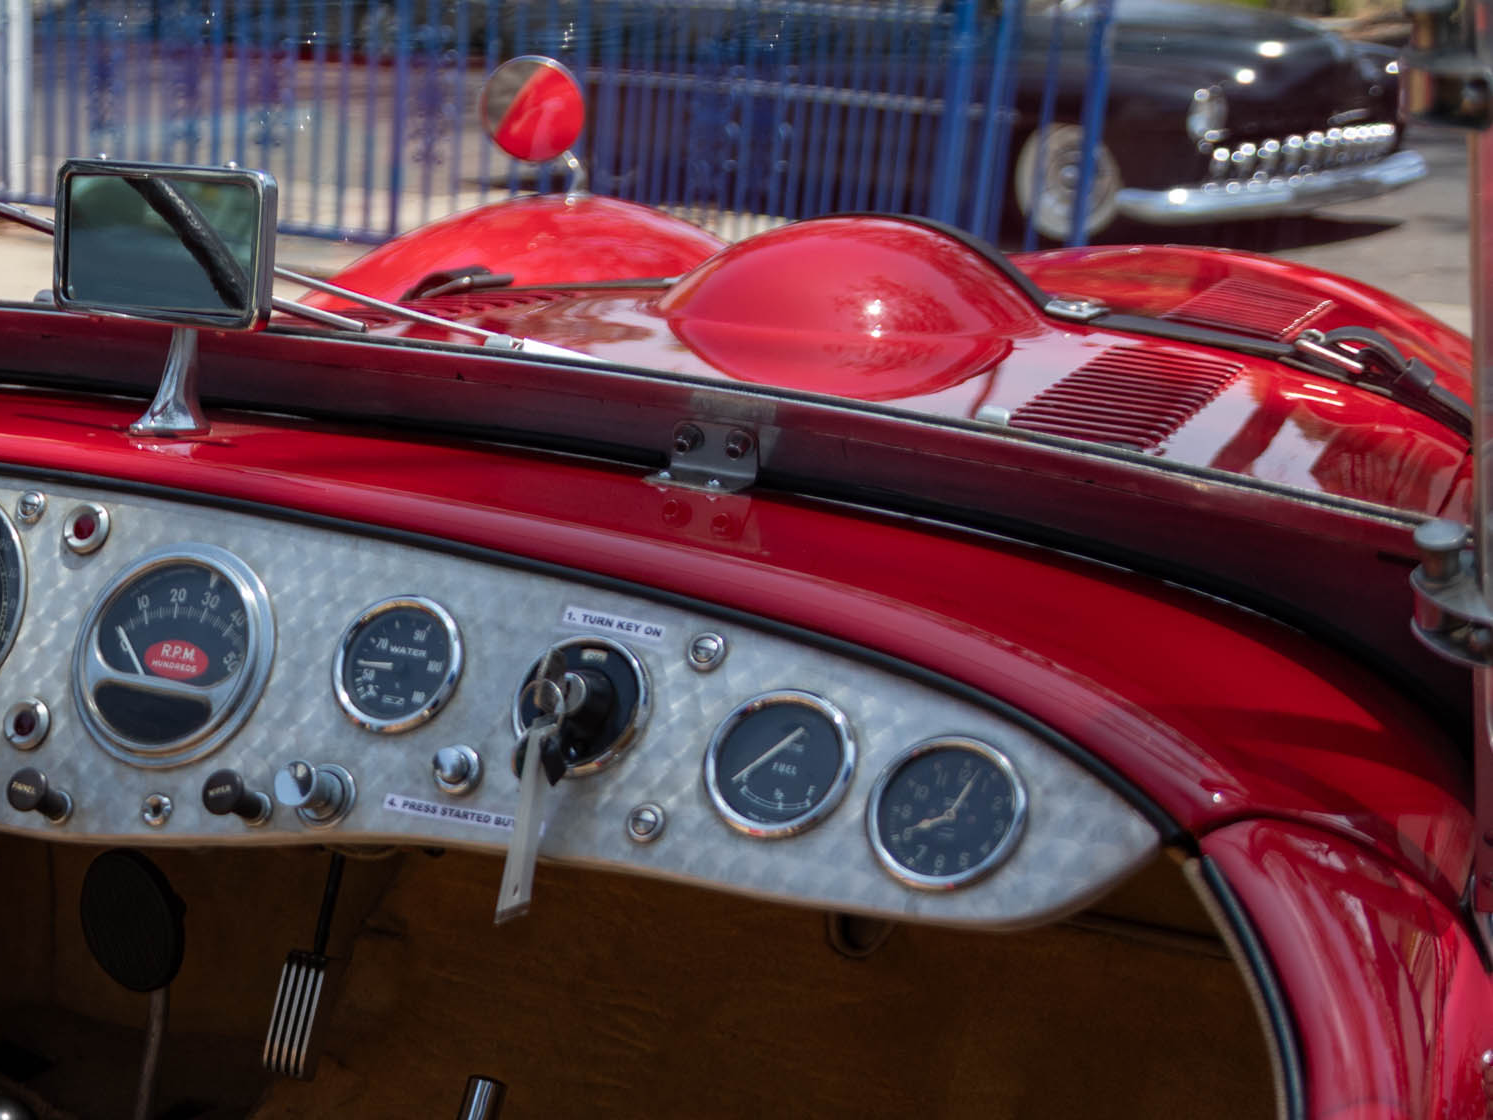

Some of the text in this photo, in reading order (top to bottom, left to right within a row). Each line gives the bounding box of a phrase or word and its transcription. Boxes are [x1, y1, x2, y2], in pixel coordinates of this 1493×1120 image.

[137, 594, 150, 609] 10
[170, 588, 186, 601] 20
[202, 592, 221, 609] 30
[230, 608, 244, 626] 40
[566, 612, 662, 638] 1. TURN KEY ON
[376, 638, 388, 649] 70
[389, 645, 427, 658] WATER
[151, 659, 198, 673] HUNDREDS
[223, 651, 241, 673] 50
[362, 669, 375, 680] 50
[771, 762, 797, 776] FUEL
[914, 784, 929, 800] 10
[993, 796, 1003, 810] 2
[387, 798, 398, 810] 4.
[401, 800, 438, 816] PRESS
[440, 806, 492, 824] STARTED
[916, 845, 928, 859] 7
[959, 852, 970, 866] 5
[935, 854, 945, 868] 6
